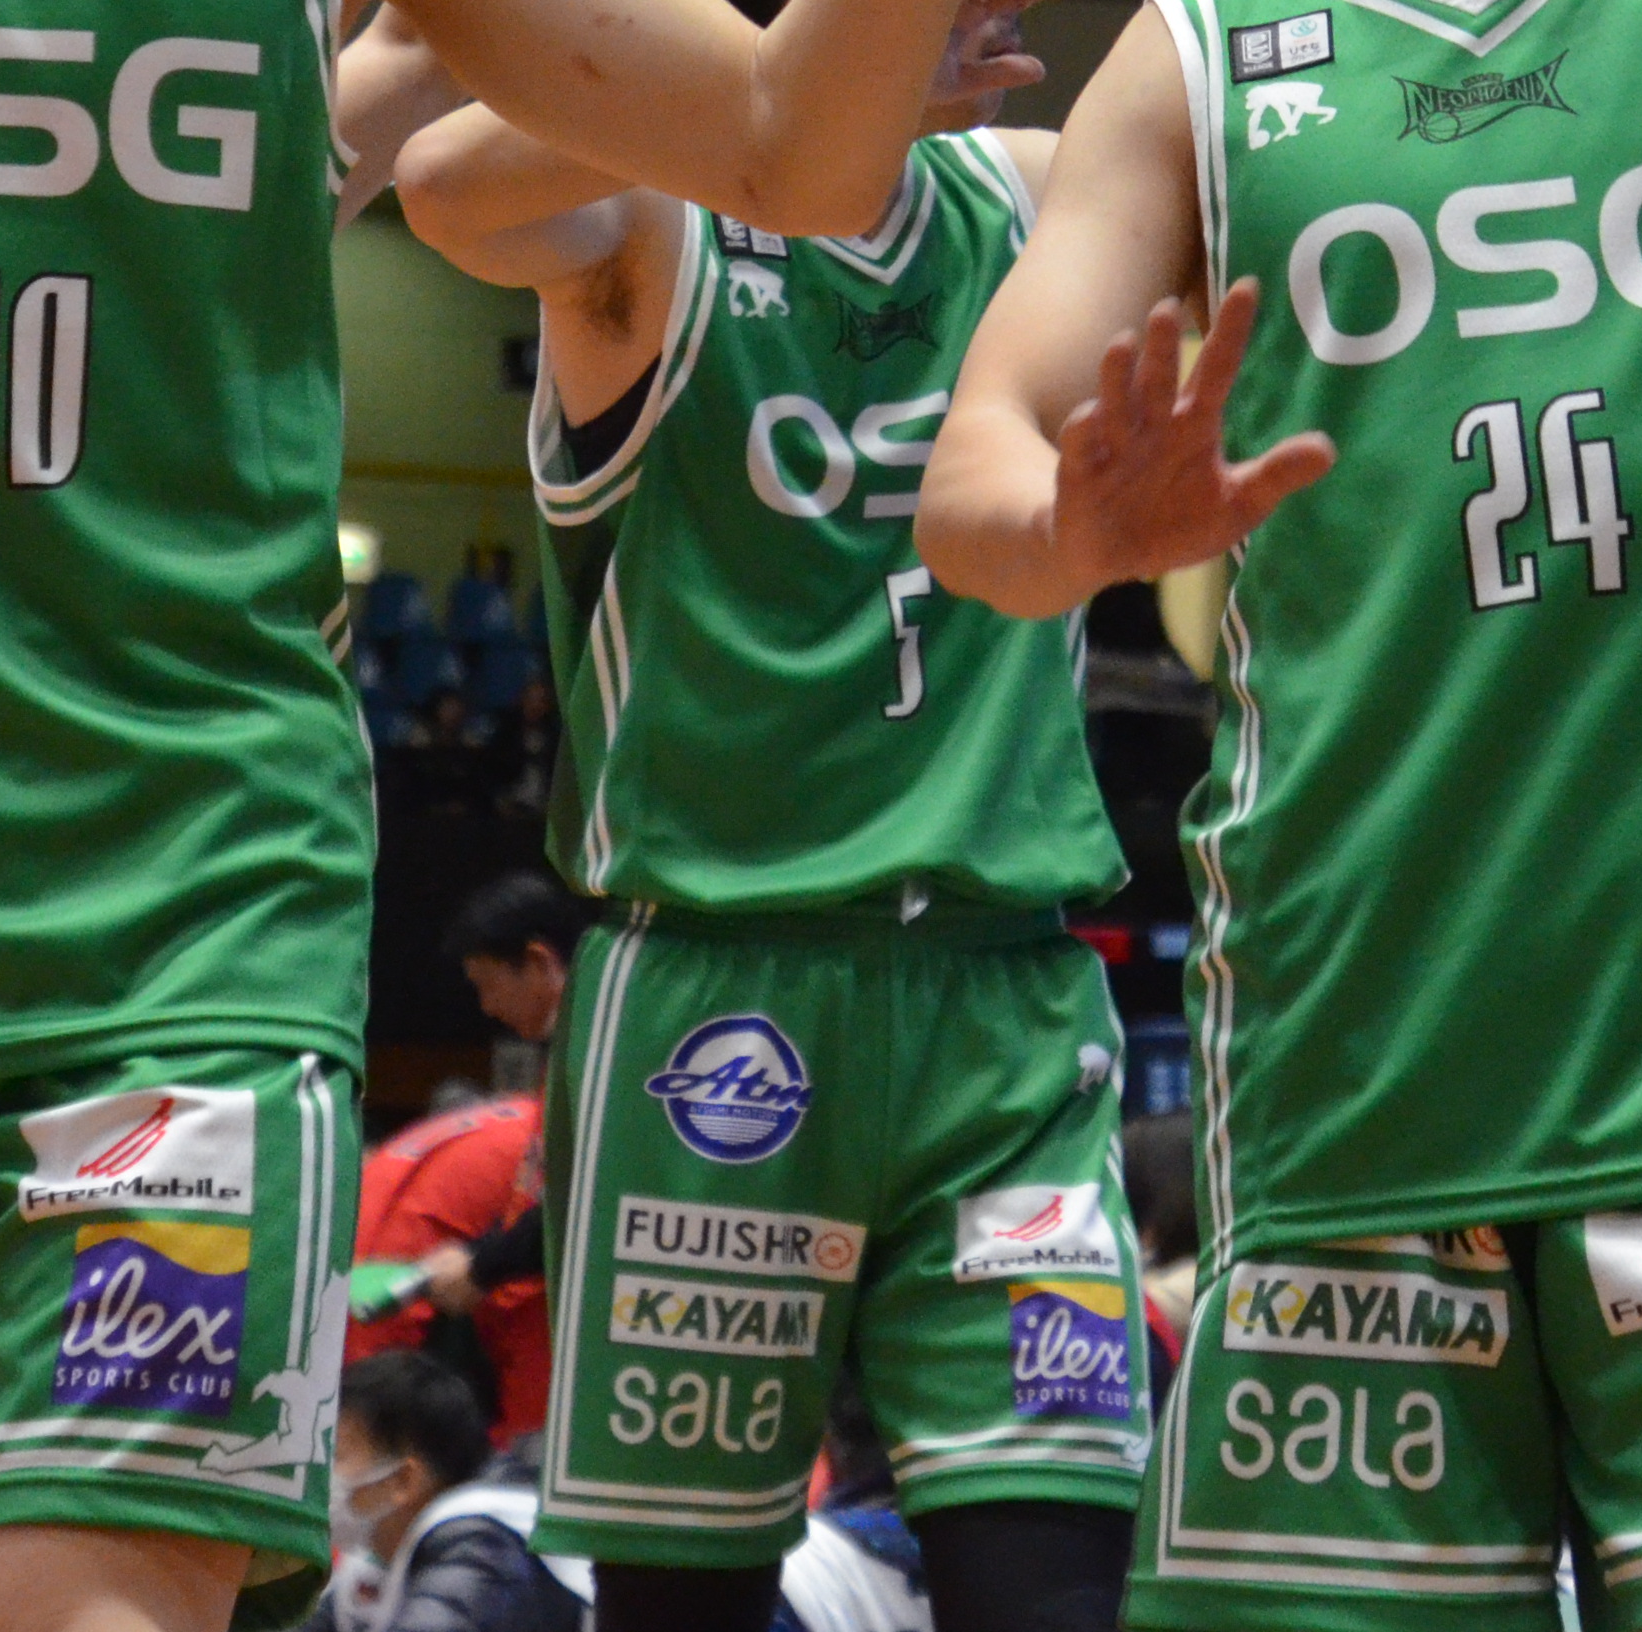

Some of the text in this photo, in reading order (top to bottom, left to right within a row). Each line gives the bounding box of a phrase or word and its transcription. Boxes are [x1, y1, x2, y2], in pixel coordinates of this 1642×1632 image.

[746, 390, 950, 519] OS
[1450, 387, 1635, 613] 24
[26, 1175, 242, 1211] FreeMobile
[62, 1256, 237, 1366] ilex
[1014, 1306, 1129, 1386] ilex
[1242, 1279, 1497, 1353] KAYAMA
[55, 1368, 233, 1399] SPORTS CLUB
[610, 1366, 785, 1454] sala
[1015, 1386, 1087, 1404] SPORTS
[1220, 1378, 1445, 1492] sala
